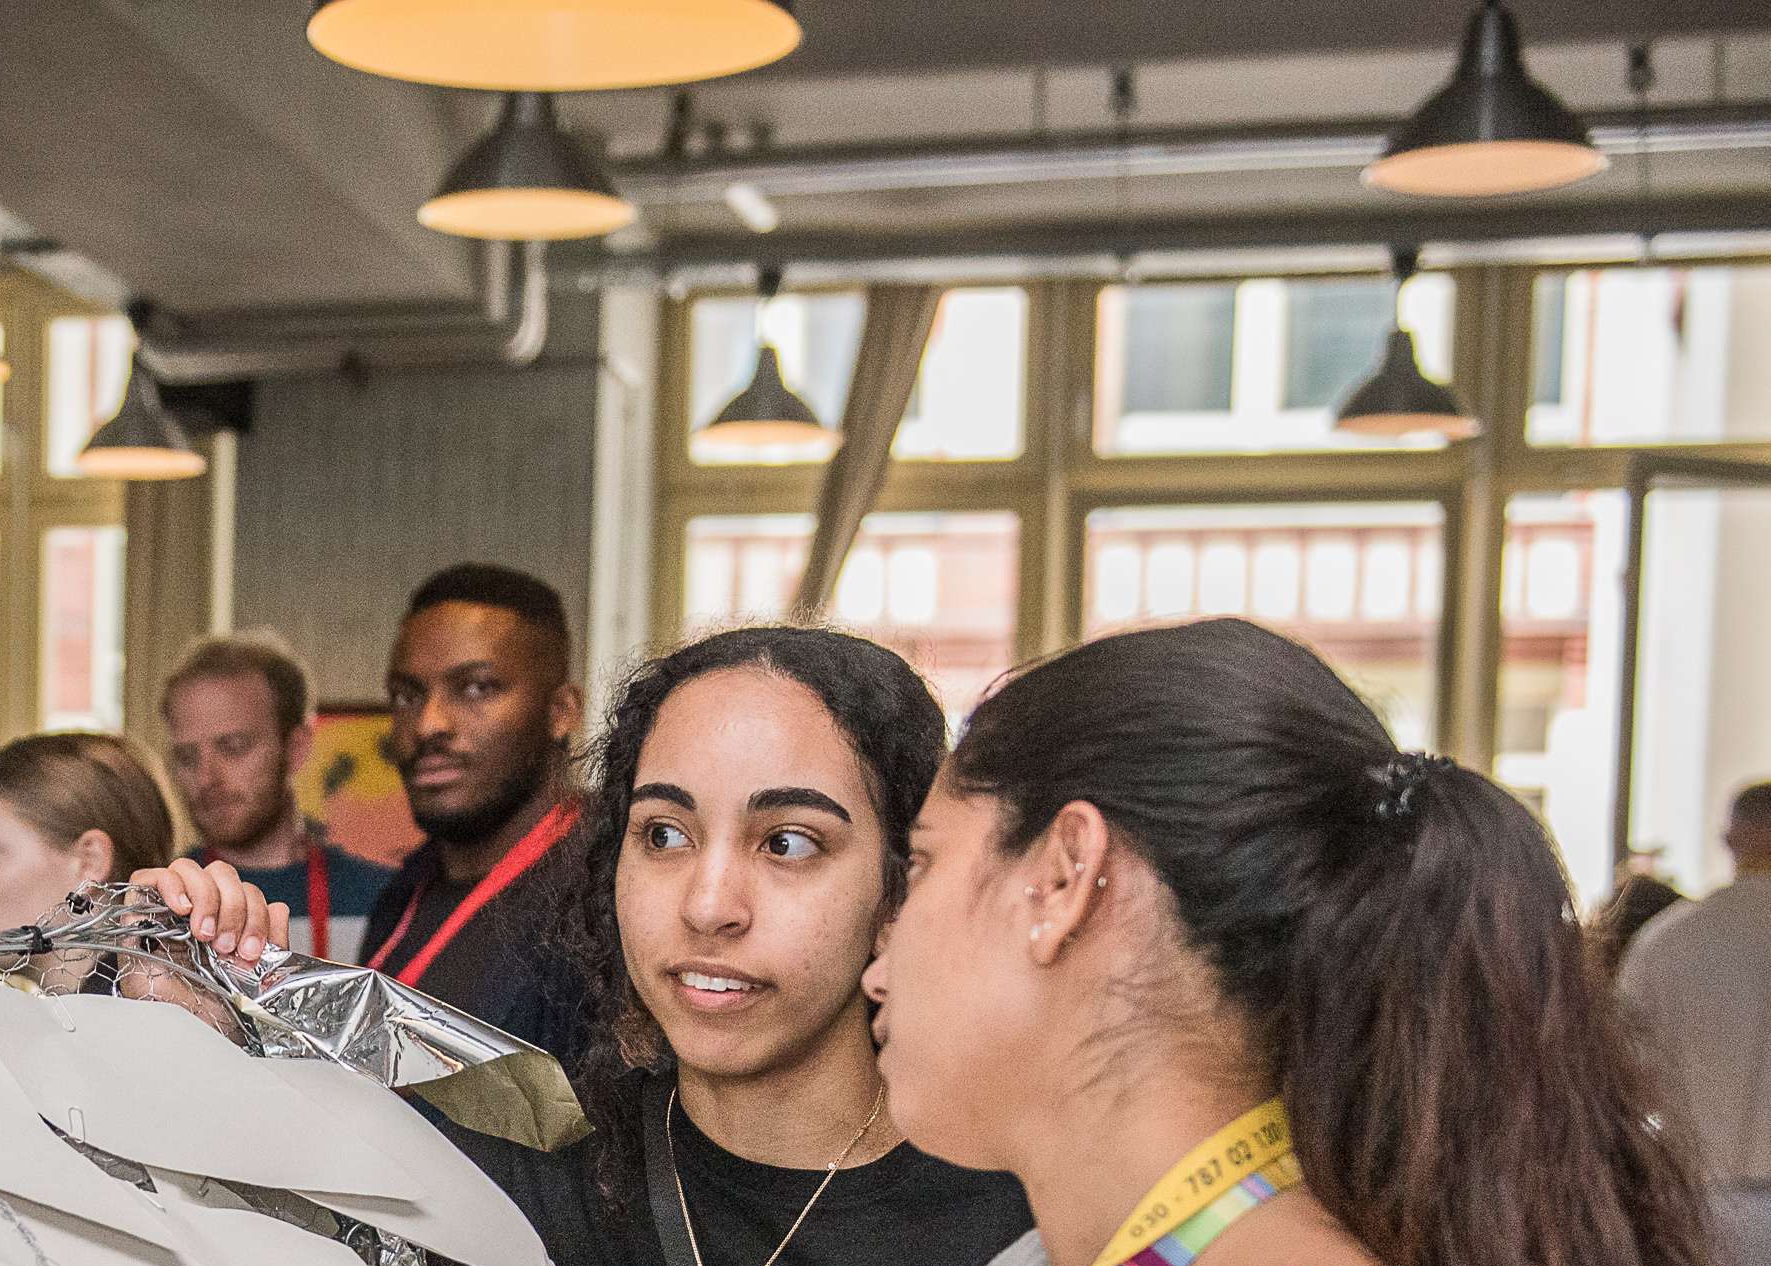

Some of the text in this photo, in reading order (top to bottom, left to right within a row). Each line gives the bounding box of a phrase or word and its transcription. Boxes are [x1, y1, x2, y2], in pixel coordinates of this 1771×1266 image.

[1129, 1203, 1169, 1238] 030
[1184, 1158, 1224, 1196] 787
[1225, 1139, 1252, 1166] 02
